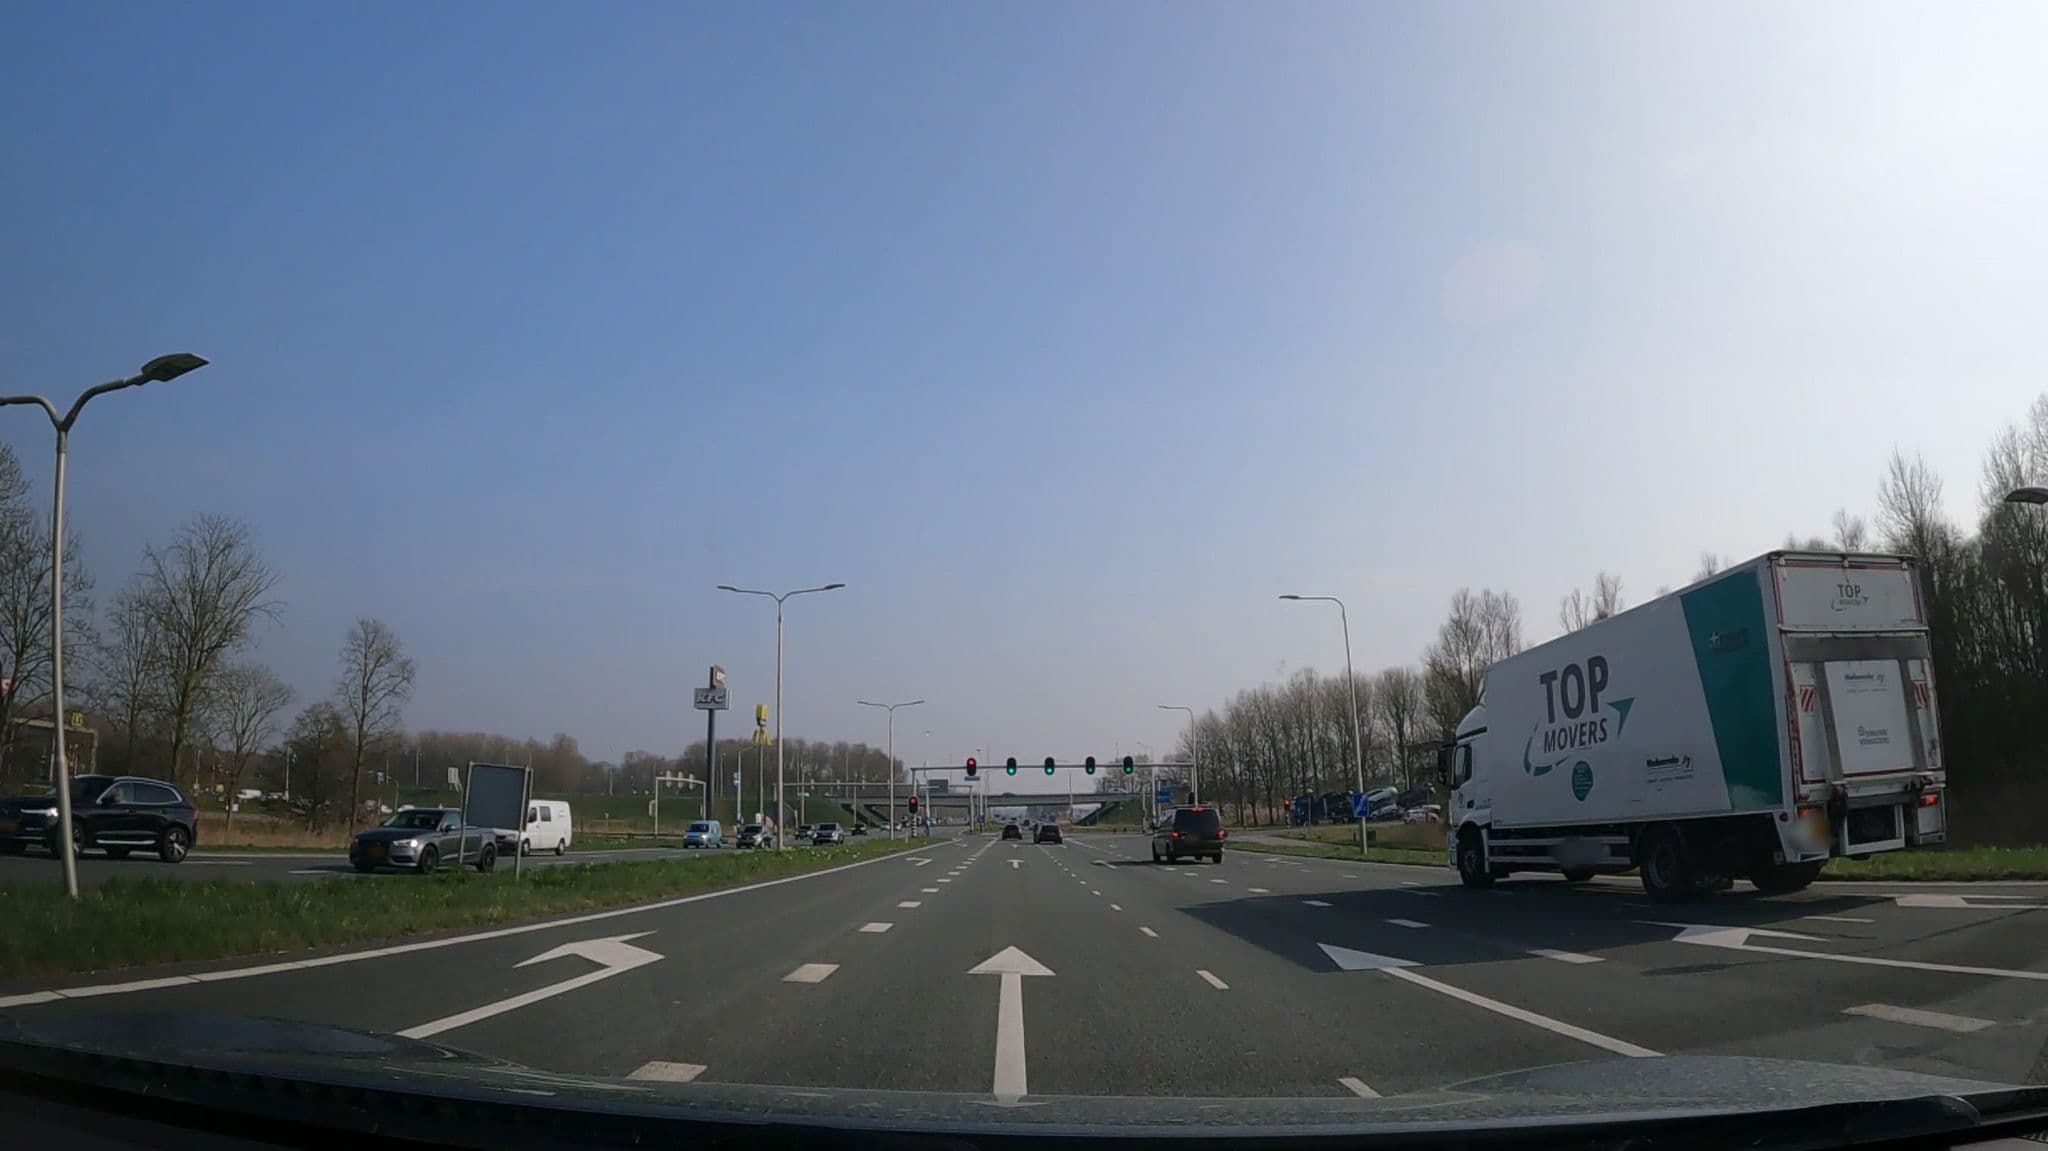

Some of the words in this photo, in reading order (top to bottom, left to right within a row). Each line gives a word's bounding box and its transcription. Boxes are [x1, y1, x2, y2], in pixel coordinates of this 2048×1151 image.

[1837, 584, 1861, 598] TOP
[1540, 655, 1608, 724] TOP
[1543, 718, 1607, 753] MOVERS
